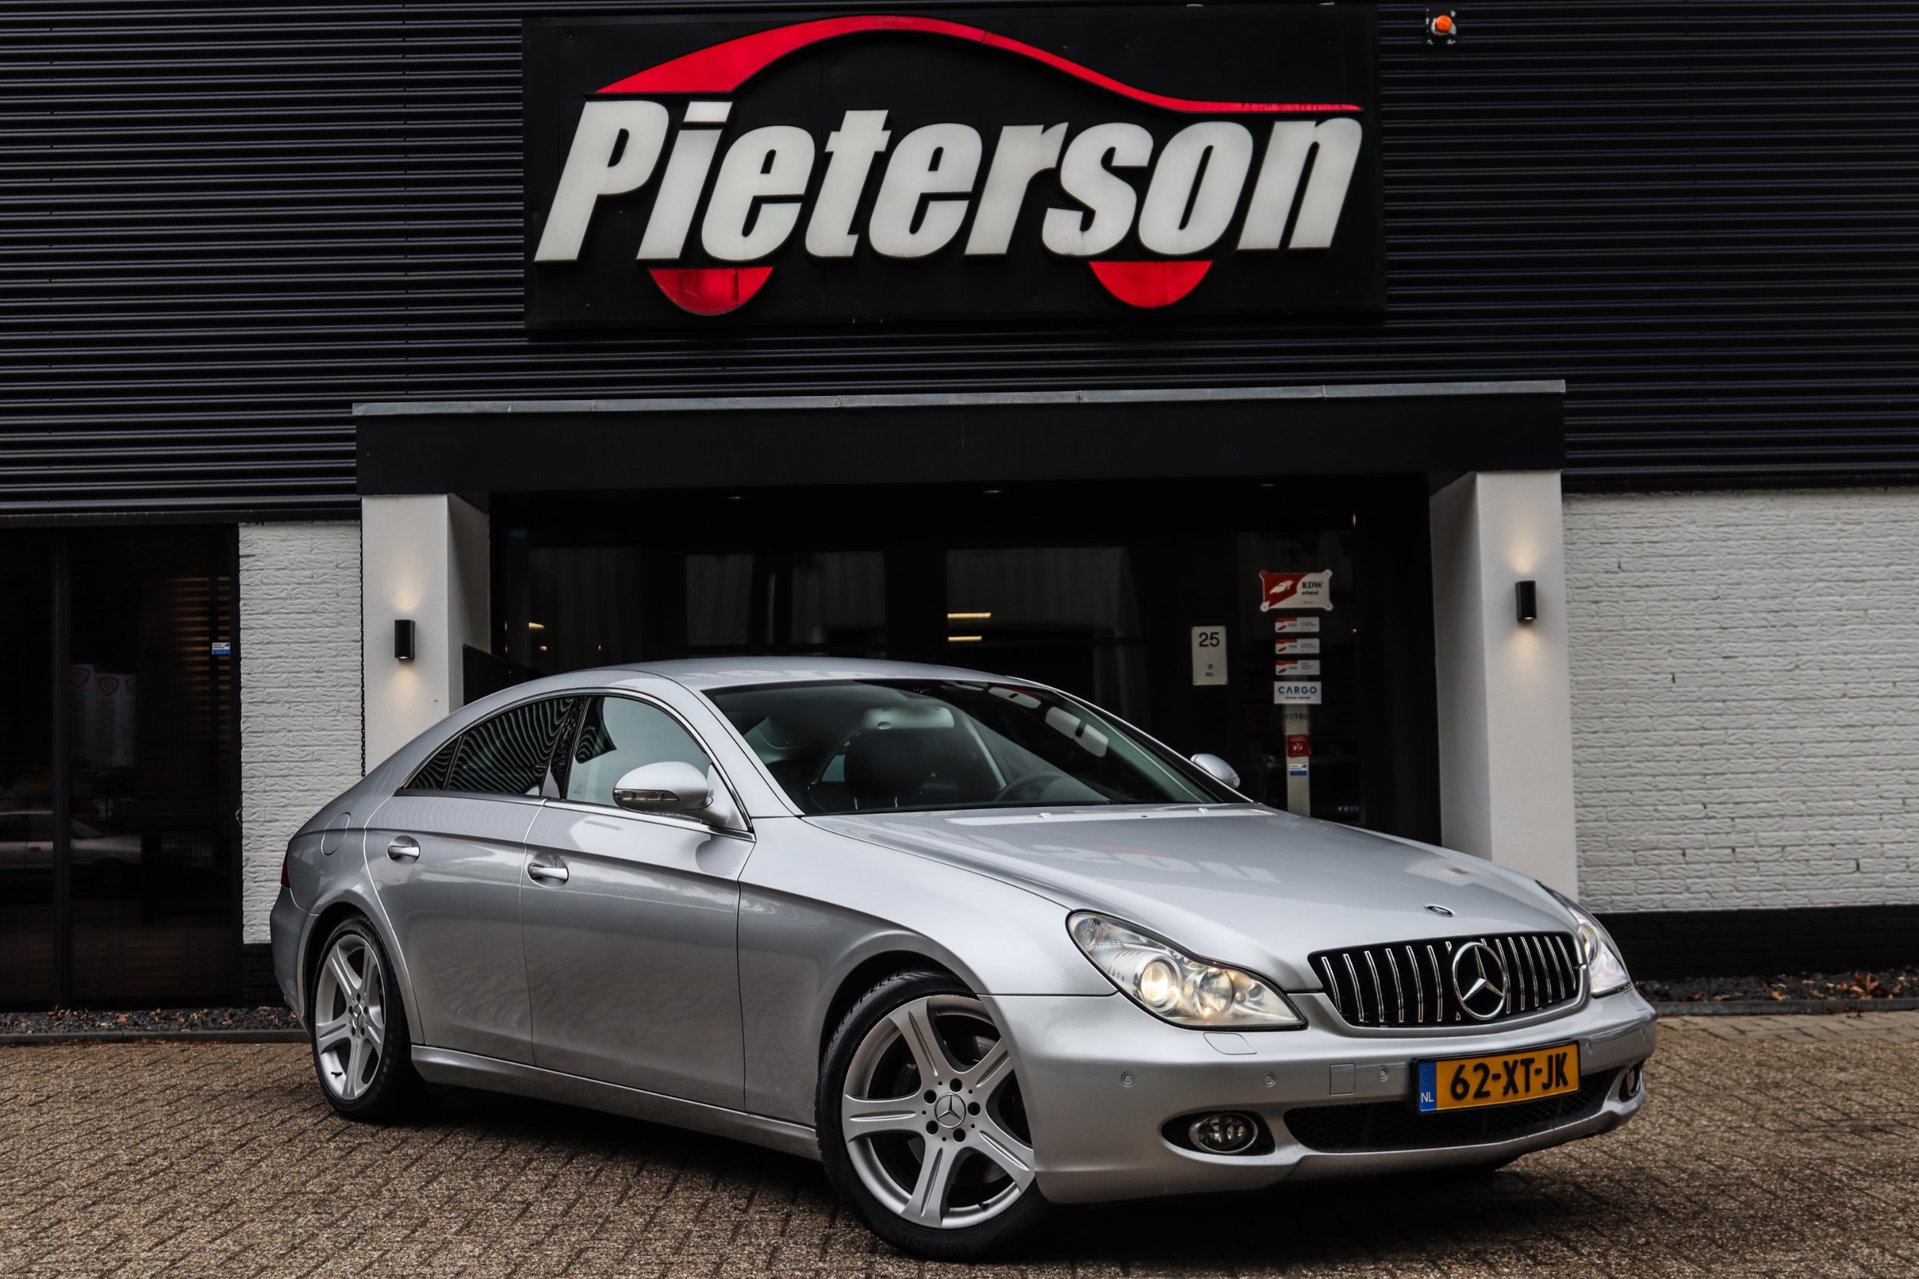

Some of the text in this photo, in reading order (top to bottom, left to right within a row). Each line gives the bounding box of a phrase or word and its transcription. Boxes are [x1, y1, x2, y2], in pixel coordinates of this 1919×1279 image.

[533, 100, 1363, 262] Pieterson
[1301, 581, 1323, 589] RDW
[1198, 631, 1220, 647] 25
[1278, 685, 1318, 695] CARGO
[1451, 1052, 1569, 1101] 62-XT-JK
[1420, 1091, 1434, 1103] NL
